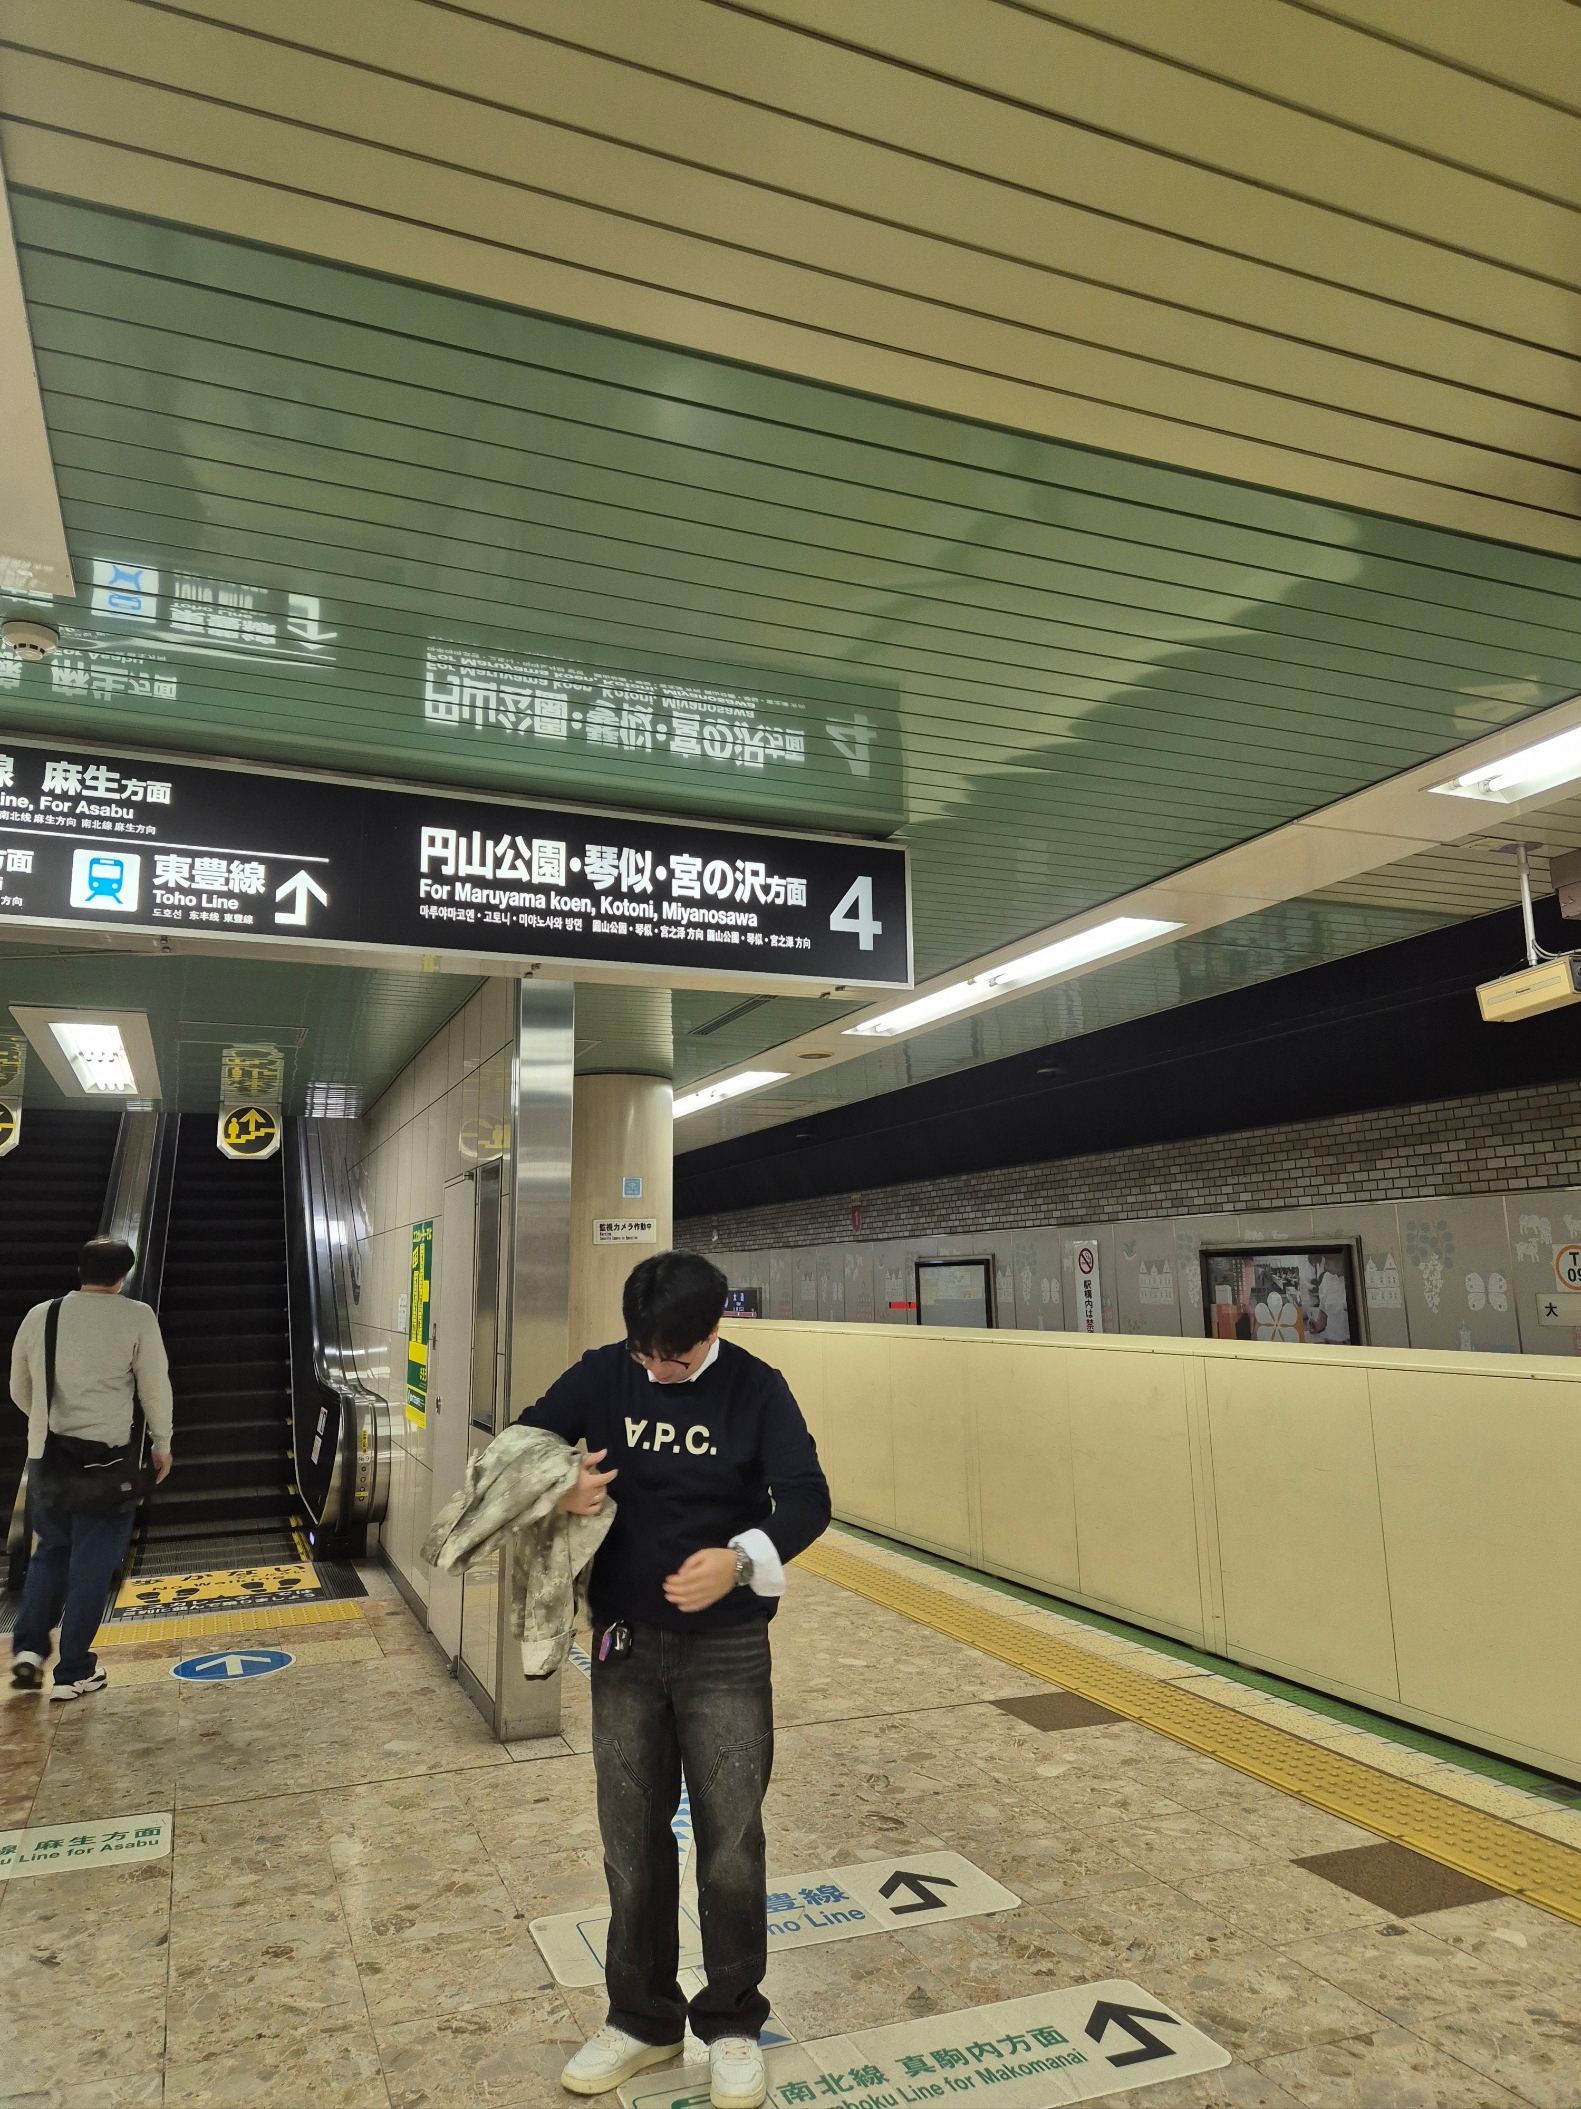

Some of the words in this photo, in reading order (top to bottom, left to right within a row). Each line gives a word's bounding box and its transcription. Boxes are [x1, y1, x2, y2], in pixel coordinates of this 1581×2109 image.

[41, 761, 172, 805] 麻生方面
[0, 792, 34, 812] ine,
[40, 796, 72, 813] For
[75, 800, 134, 819] Asabu
[152, 854, 266, 894] 東豊線
[152, 889, 197, 908] Toho
[201, 894, 239, 910] Line
[419, 879, 451, 900] For
[454, 881, 546, 909] Maruyama
[550, 891, 597, 916] koen,
[600, 895, 658, 922] Kotoni,
[662, 901, 758, 928] Miyanosawa
[829, 875, 883, 951] 4
[599, 1222, 652, 1232] 監視カメラ作動中
[1568, 1251, 1580, 1266] T
[1083, 1280, 1095, 1333] 駅構内は禁
[1544, 1302, 1559, 1317] 大
[19, 1852, 60, 1863] Line
[67, 1846, 95, 1857] for
[100, 1838, 159, 1853] Asabu
[34, 1826, 163, 1851] 麻生方面
[803, 1908, 866, 1928] Line
[775, 2064, 891, 2106] 南北線
[894, 2025, 1070, 2078] 真駒内方面
[896, 2083, 945, 2103] Line
[943, 2074, 977, 2093] for
[973, 2047, 1089, 2086] Makomanai
